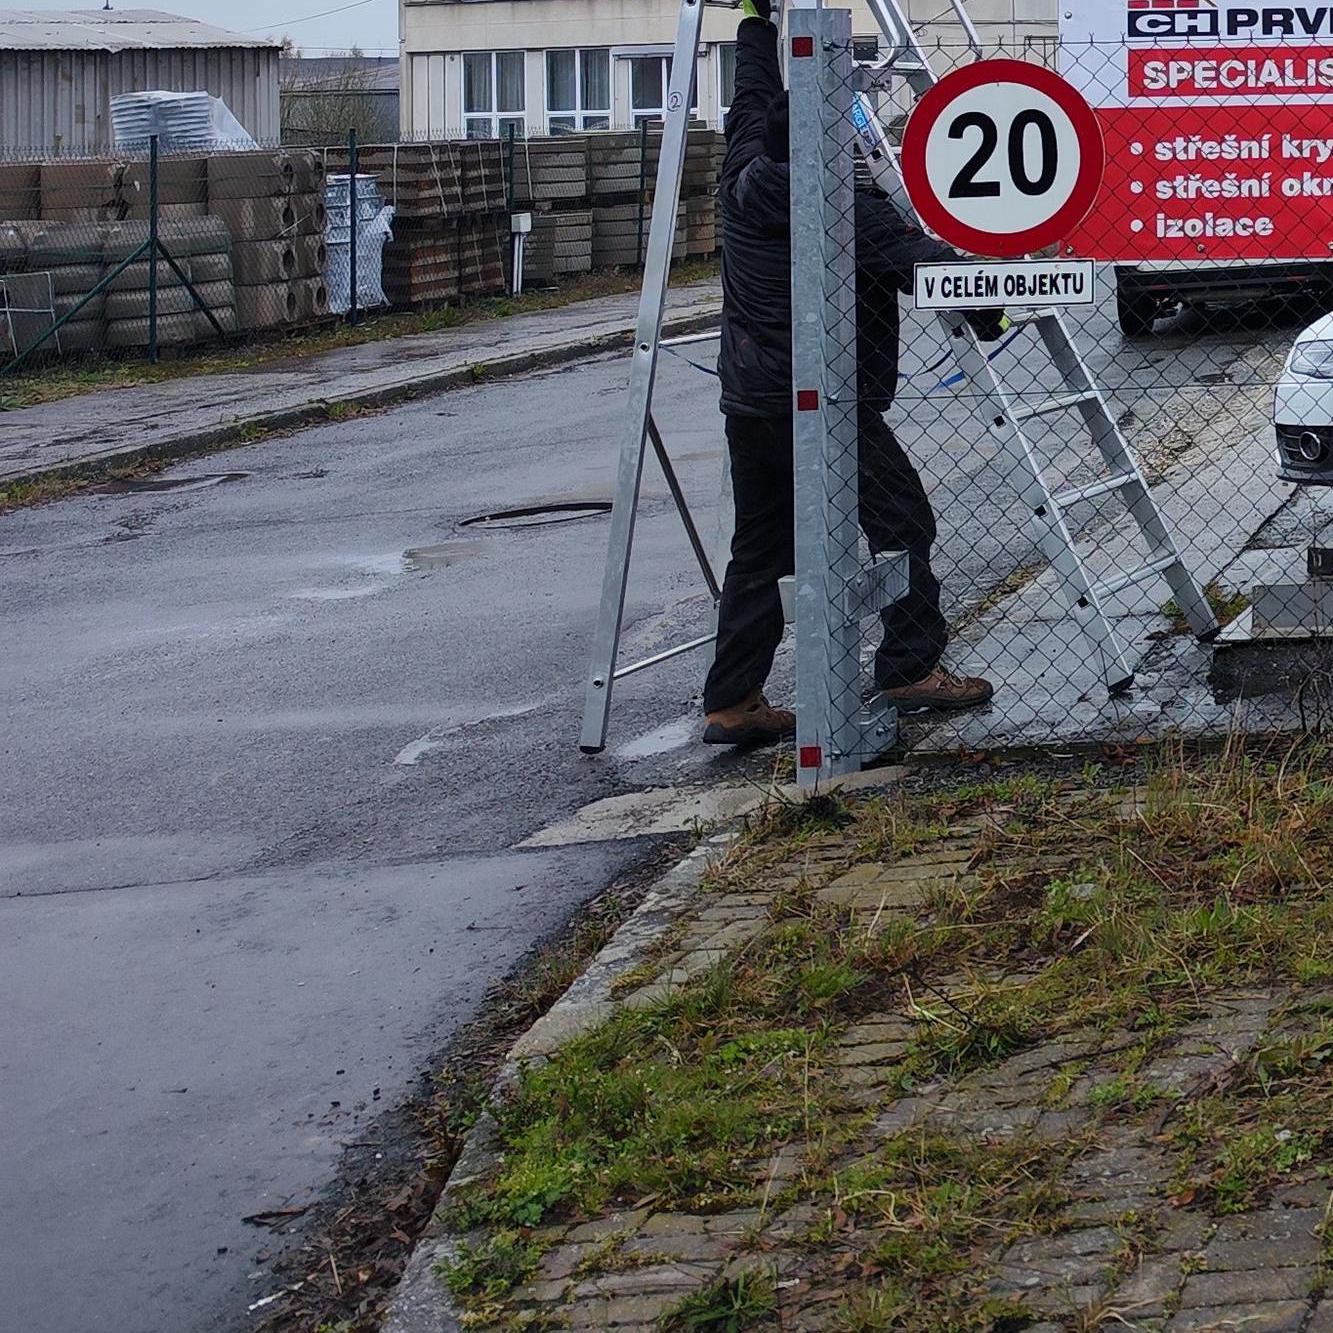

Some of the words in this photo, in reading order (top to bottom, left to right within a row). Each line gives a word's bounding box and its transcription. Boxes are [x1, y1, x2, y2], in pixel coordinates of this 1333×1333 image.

[1134, 12, 1212, 34] CH
[947, 109, 1059, 199] 20
[1154, 134, 1273, 161] střešní
[1155, 172, 1273, 199] střešní
[1155, 212, 1275, 238] izolace
[924, 276, 935, 299] V
[940, 269, 999, 298] CELÉM
[1003, 272, 1084, 297] OBJEKTU
